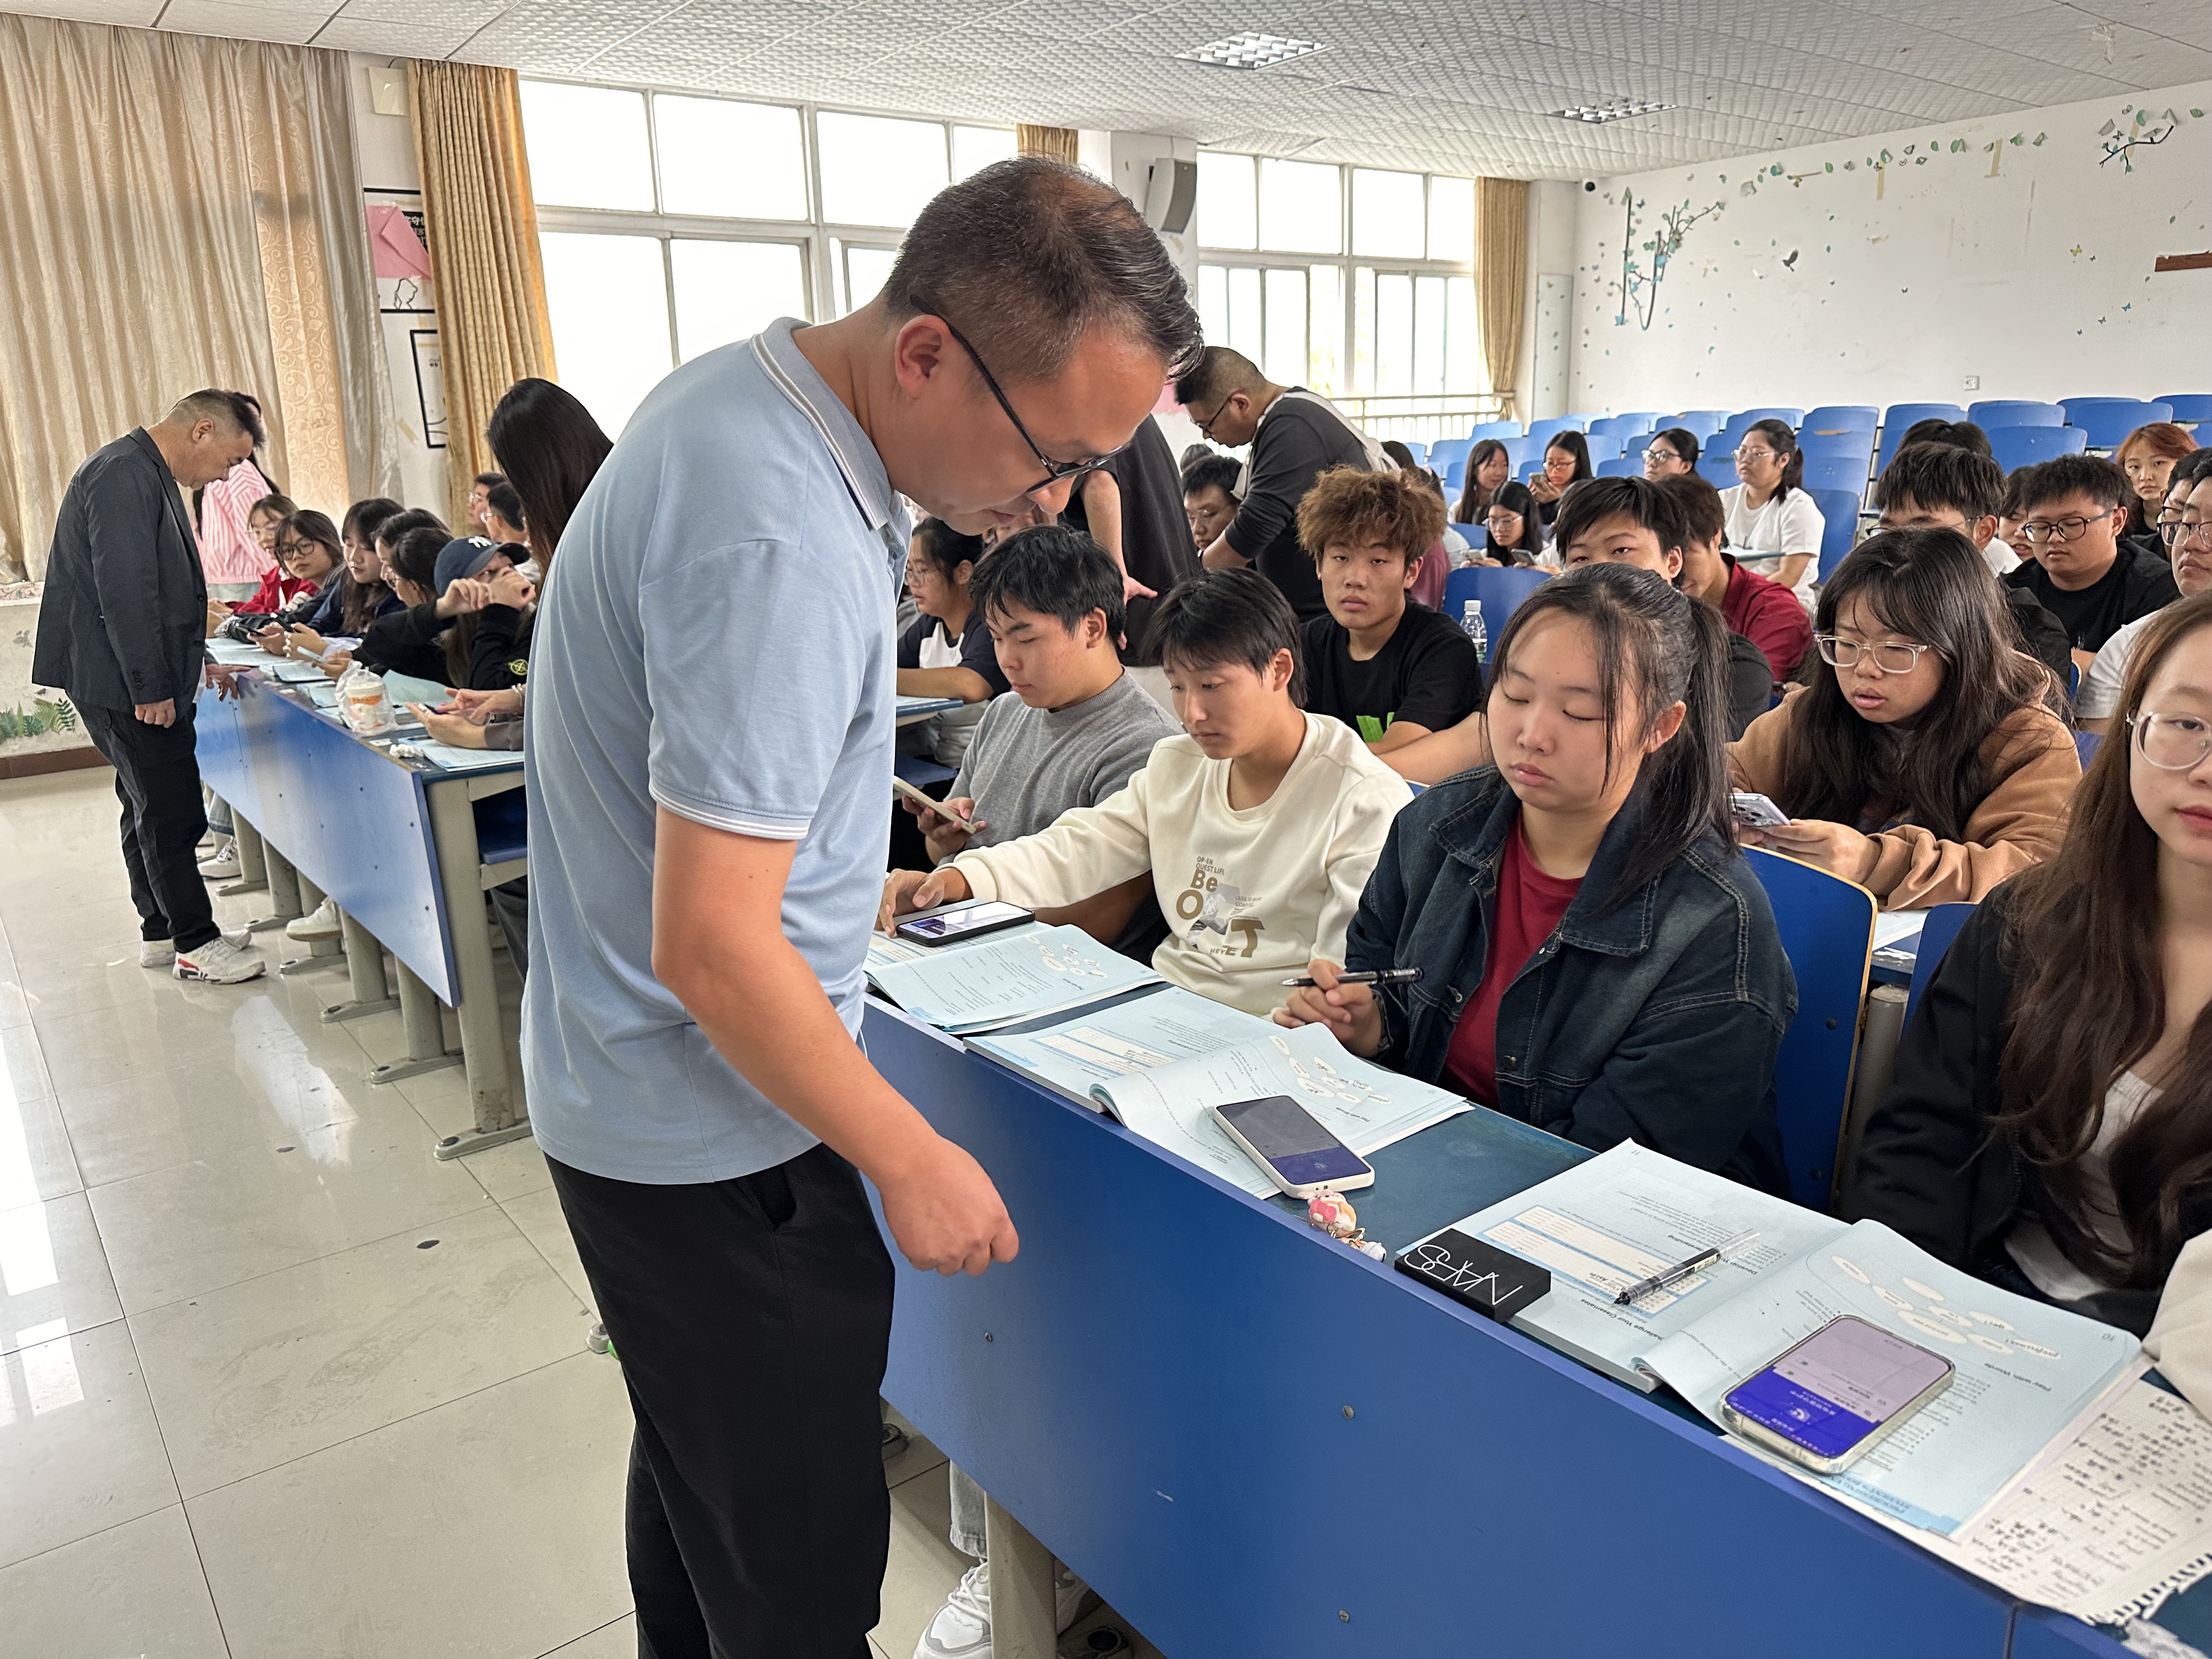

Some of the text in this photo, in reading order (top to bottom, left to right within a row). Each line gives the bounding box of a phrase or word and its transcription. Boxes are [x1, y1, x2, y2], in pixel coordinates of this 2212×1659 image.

[1197, 856, 1213, 865] OP-EN
[1195, 863, 1214, 872] QUEST
[1190, 868, 1217, 892] Be
[1404, 1244, 1523, 1306] NARS
[1729, 1261, 1758, 1276] Develop
[1579, 1298, 1617, 1319] Classmates
[1616, 1316, 1633, 1327] Your
[2100, 1331, 2117, 1343] 10
